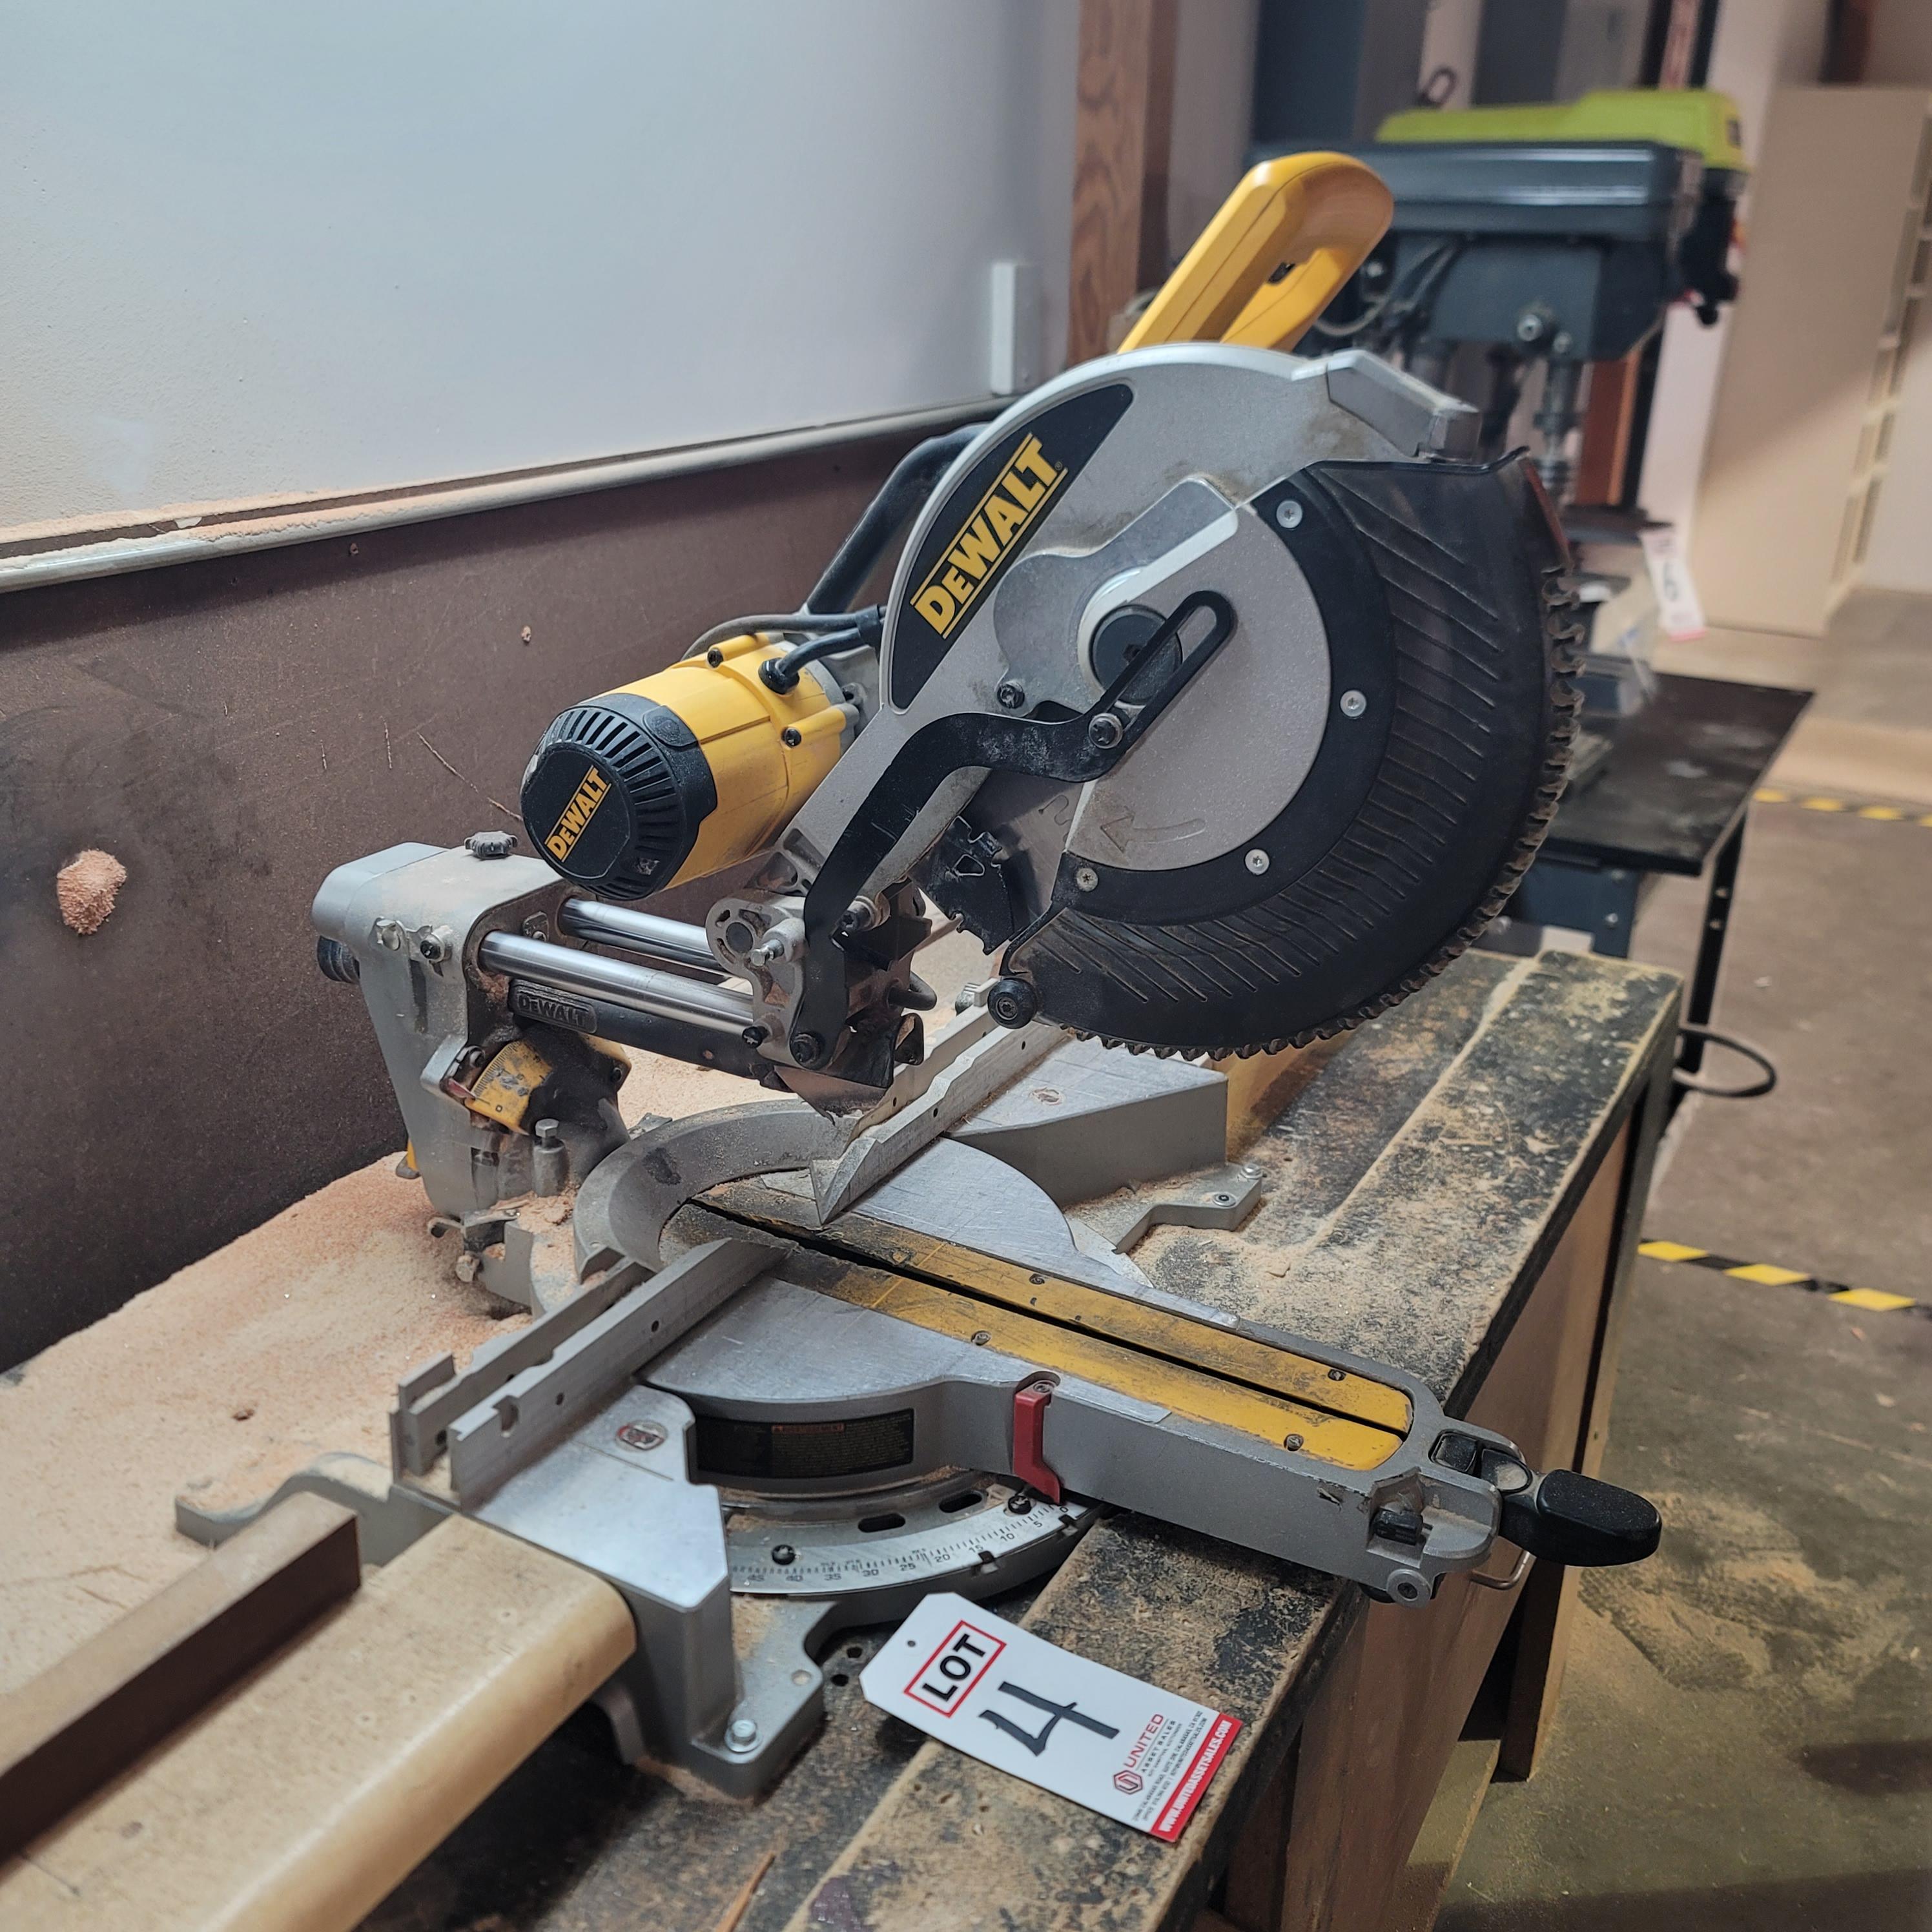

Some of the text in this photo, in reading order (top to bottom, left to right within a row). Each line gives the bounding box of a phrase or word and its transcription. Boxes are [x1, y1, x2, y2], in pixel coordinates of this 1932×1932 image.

[912, 435, 1058, 636] DEWALT
[547, 767, 608, 861] DEWALT
[518, 994, 586, 1027] DEWALT
[899, 1563, 916, 1571] 25
[934, 1554, 951, 1563] 20
[969, 1545, 983, 1553] 15
[1000, 1533, 1015, 1542] 10
[922, 1633, 986, 1702] LOT
[978, 1681, 1120, 1757] 4
[1124, 1713, 1164, 1768] UNITED
[1141, 1745, 1161, 1773] ASSET
[1158, 1720, 1176, 1745] SALES
[1158, 1719, 1233, 1832] WWW.UNITEDASSETSALES.COM
